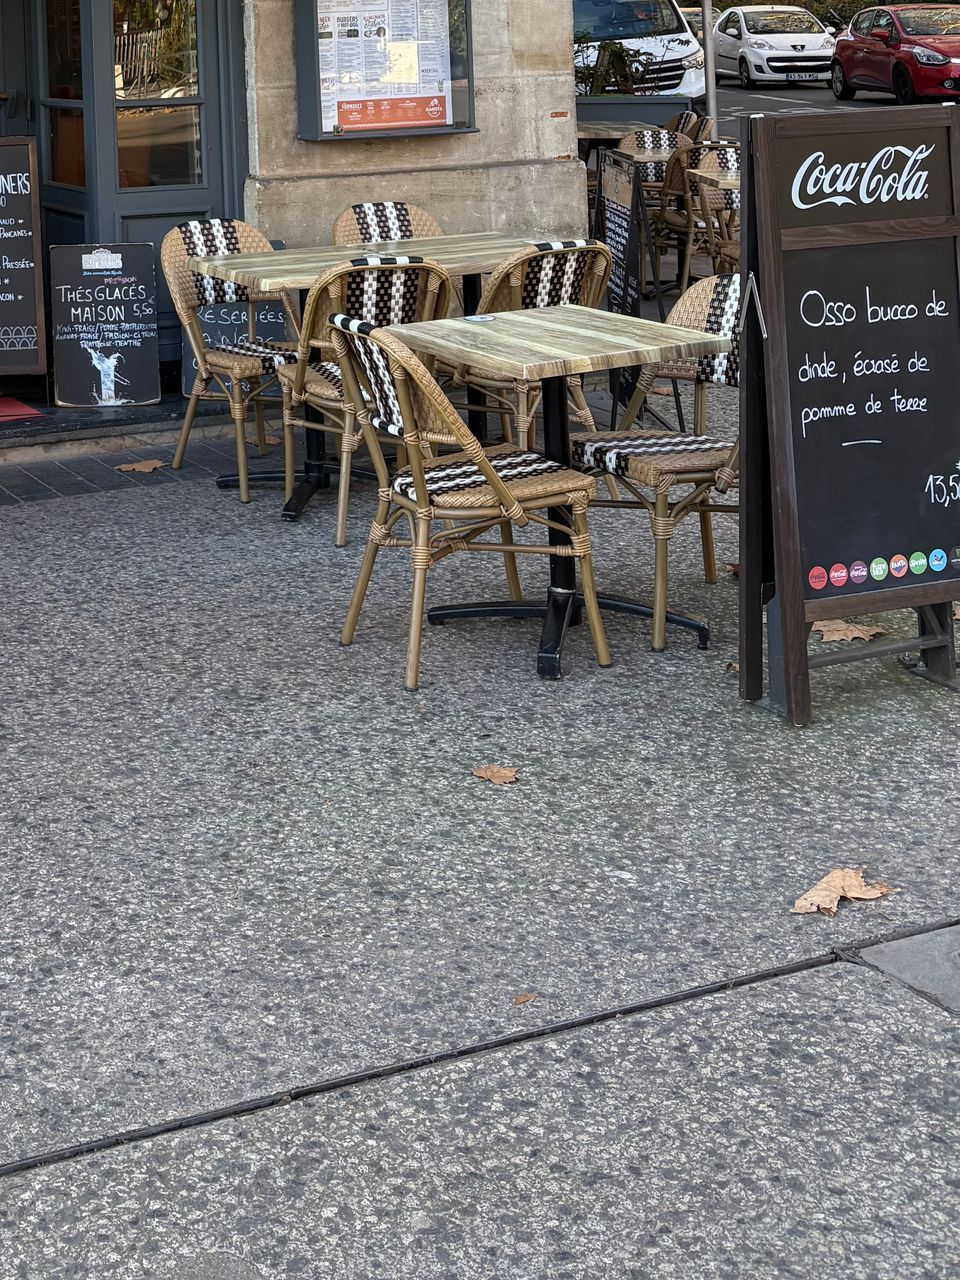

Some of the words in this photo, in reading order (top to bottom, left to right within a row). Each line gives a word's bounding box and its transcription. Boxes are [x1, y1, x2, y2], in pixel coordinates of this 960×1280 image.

[791, 144, 936, 209] Coca-Cola
[2, 255, 31, 270] PRESSÉE
[55, 285, 93, 302] THÉS
[94, 283, 146, 301] GLACÉS
[800, 290, 856, 327] Osso
[866, 286, 918, 323] bucco
[926, 289, 949, 317] de
[133, 302, 153, 318] 5,50
[853, 351, 901, 376] écrasé
[907, 351, 930, 372] de
[801, 403, 857, 438] pomme
[865, 393, 883, 415] de
[890, 388, 928, 412] terre
[925, 474, 960, 507] 13,5
